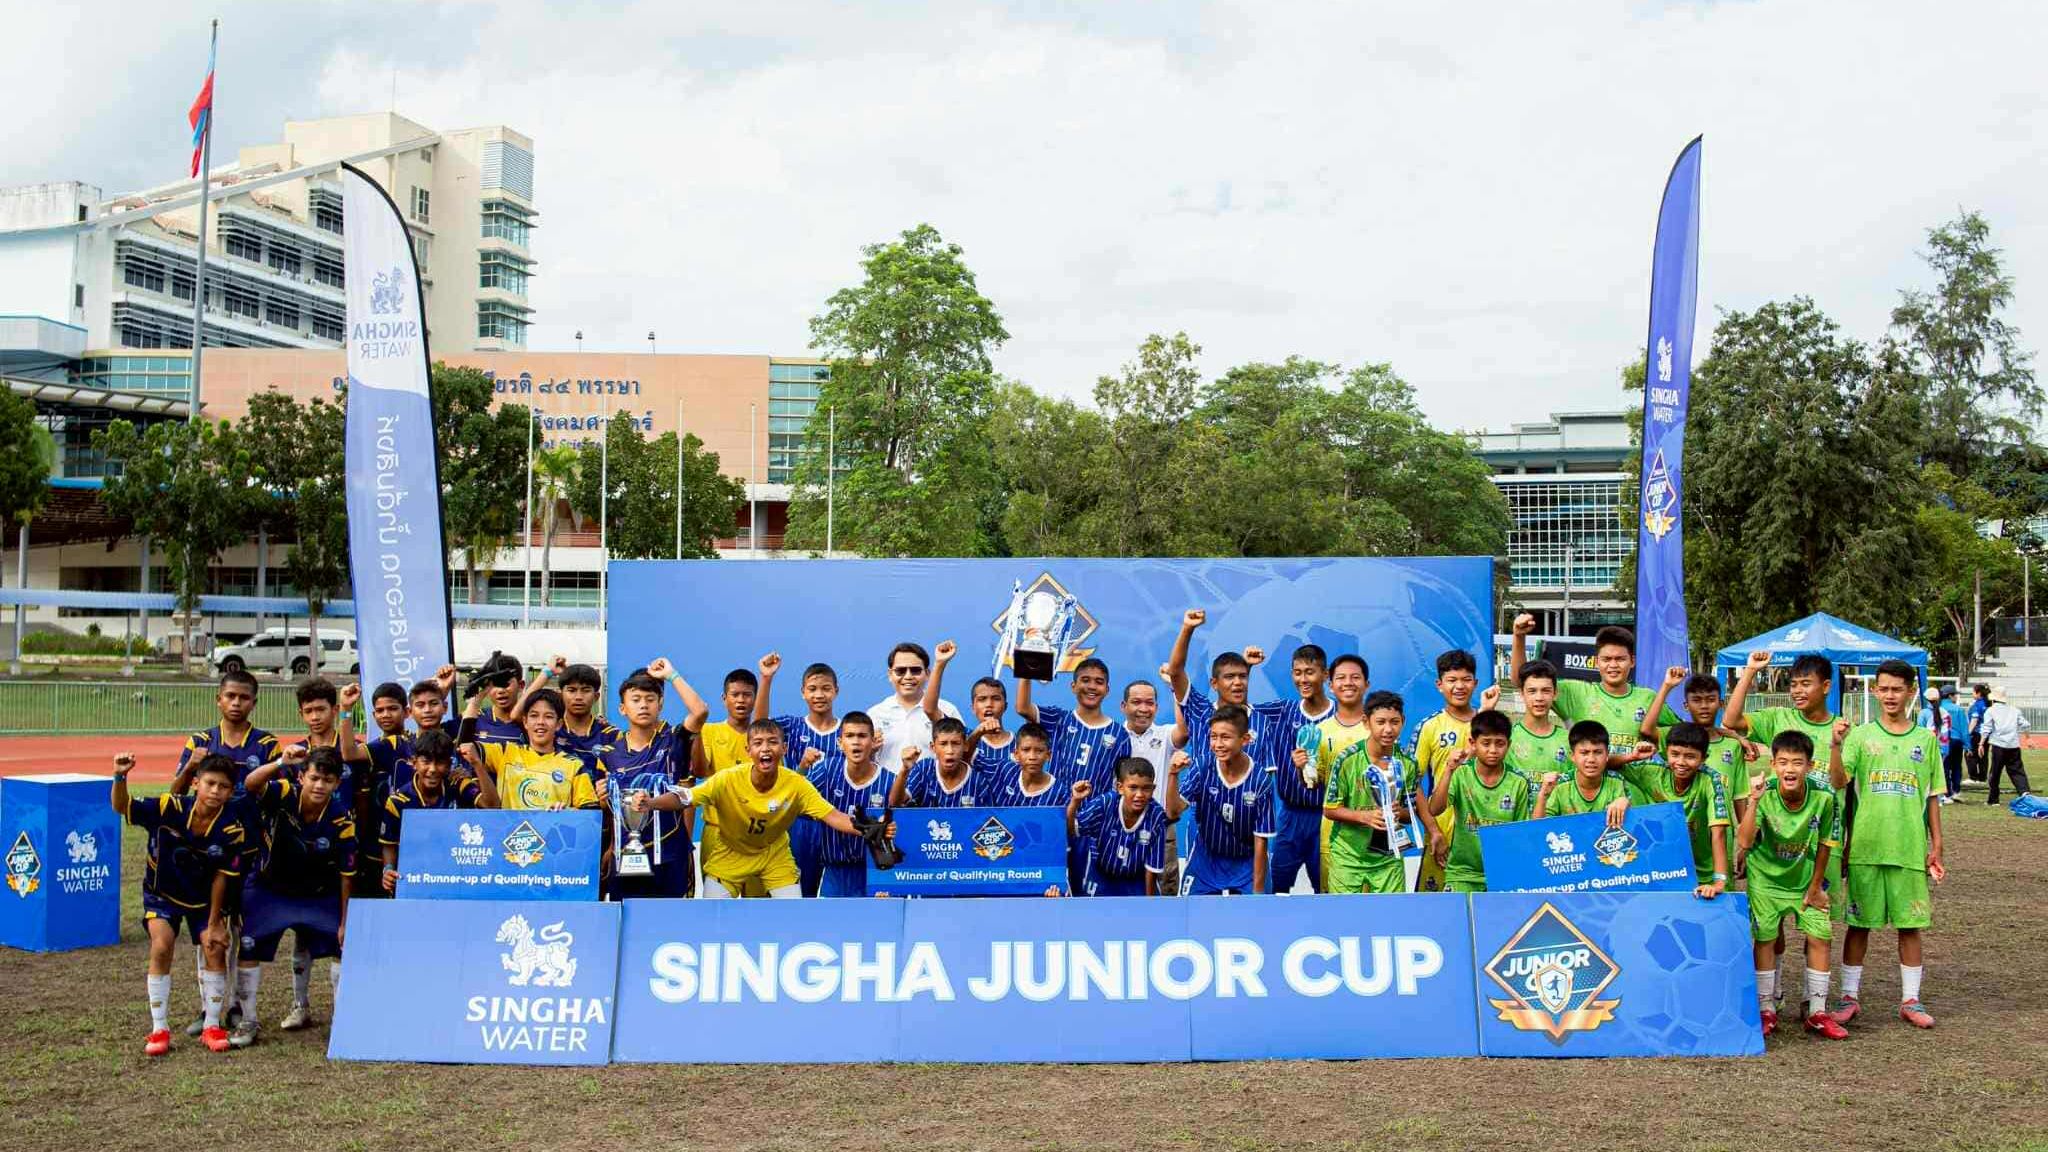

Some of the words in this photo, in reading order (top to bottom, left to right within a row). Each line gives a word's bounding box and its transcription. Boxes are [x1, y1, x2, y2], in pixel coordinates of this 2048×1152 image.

[577, 379, 640, 395] พรรษา
[1651, 387, 1679, 406] SINGHA
[1653, 406, 1673, 423] WATER
[1564, 654, 1596, 669] BOXd
[1440, 731, 1457, 748] 59
[1077, 743, 1091, 766] 3
[748, 816, 767, 834] 15
[451, 847, 493, 857] SINGHA
[921, 843, 963, 852] SINGHA
[926, 852, 959, 860] WATER
[1117, 845, 1130, 867] 4
[456, 857, 489, 866] WATER
[1542, 853, 1586, 867] SINGHA
[56, 865, 109, 882] SINGHA
[895, 871, 933, 881] Winner
[936, 870, 947, 880] of
[949, 870, 1006, 884] Qualifying
[1008, 869, 1042, 880] Round
[1549, 863, 1584, 875] WATER
[63, 878, 103, 893] WATER
[406, 873, 421, 883] 1st
[423, 873, 478, 886] Runner-up
[480, 873, 492, 883] of
[495, 873, 551, 888] Qualifying
[554, 874, 589, 885] Round
[1577, 879, 1590, 891] of
[1591, 873, 1650, 890] Qualifying
[1652, 867, 1688, 881] Round
[650, 941, 955, 1003] SINGHA
[967, 937, 1269, 1002] JUNIOR
[1281, 935, 1444, 997] CUP
[1502, 949, 1591, 977] JUNIOR
[465, 996, 606, 1024] SINGHA
[479, 1026, 588, 1052] WATER
